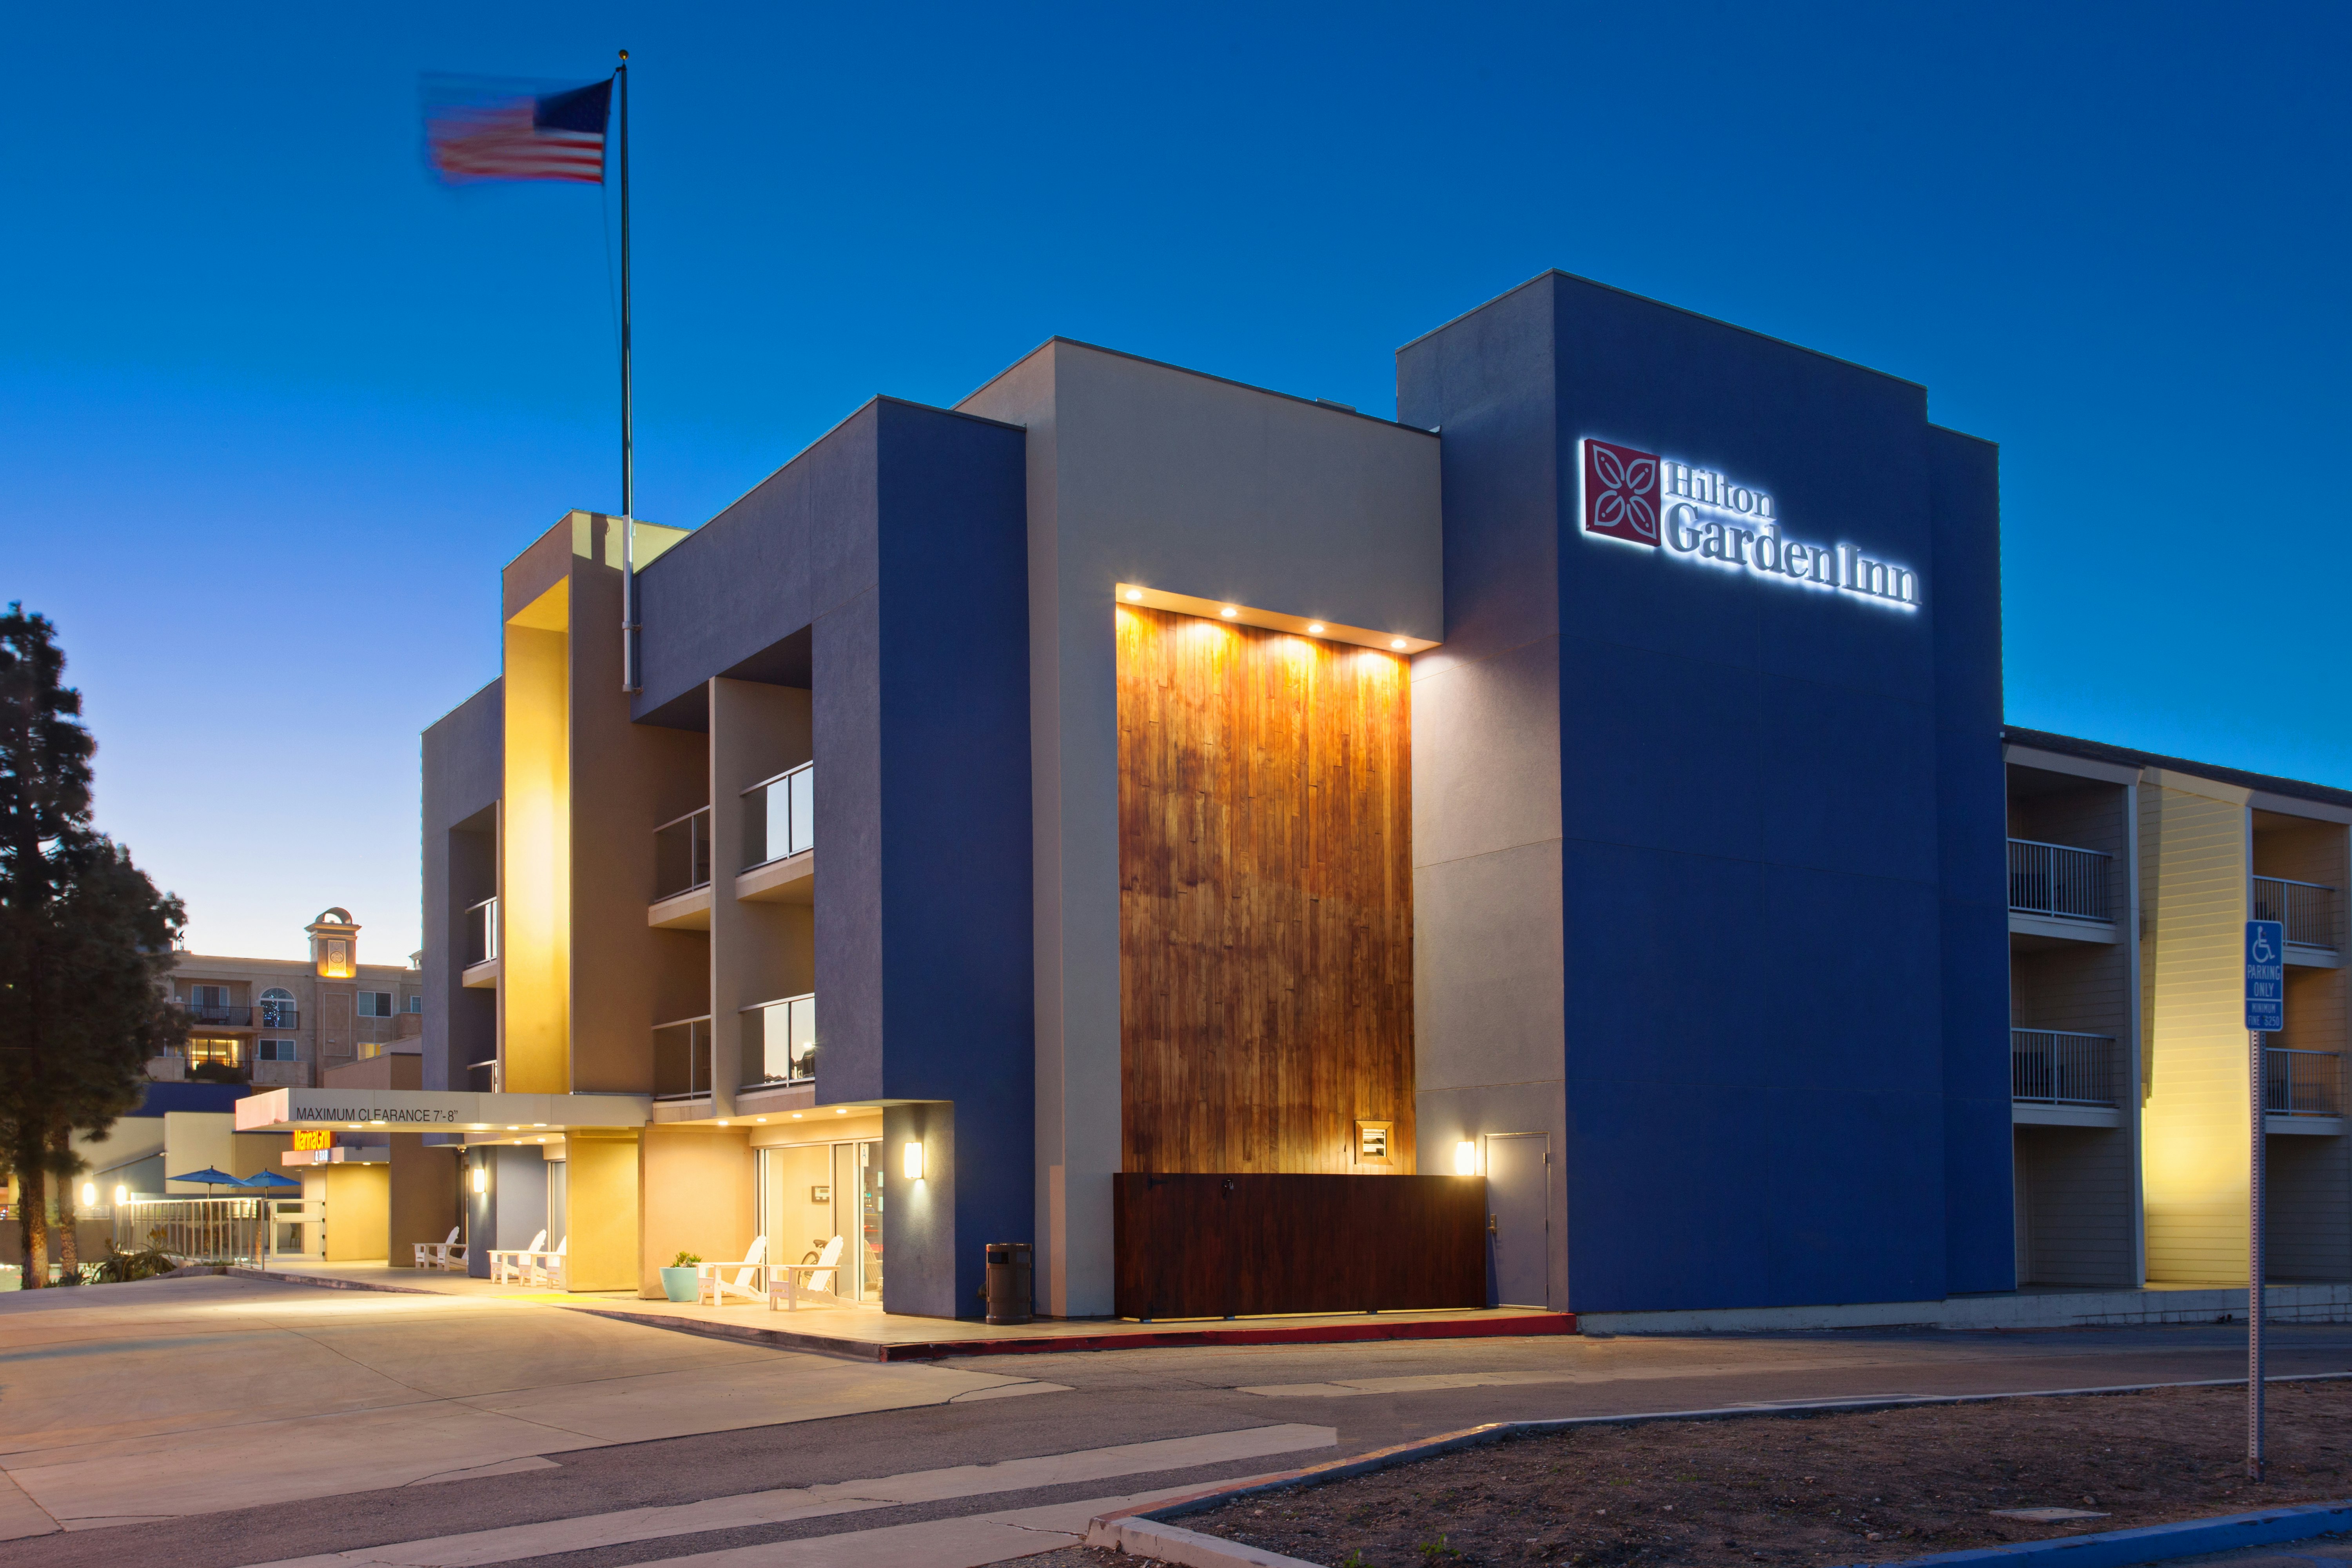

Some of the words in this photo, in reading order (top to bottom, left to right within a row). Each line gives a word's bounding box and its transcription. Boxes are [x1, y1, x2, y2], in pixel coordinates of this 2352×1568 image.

[1664, 461, 1777, 522] Hilton
[1665, 502, 1840, 588] Garden
[1838, 543, 1922, 605] Inn
[2247, 964, 2280, 980] PARKING
[2254, 982, 2274, 997] ONLY
[2251, 1003, 2276, 1013] MINIMUM
[2248, 1015, 2260, 1025] FINE
[2264, 1016, 2280, 1026] $250
[297, 1107, 355, 1121] MAXIMUM
[358, 1108, 430, 1122] CLEARANCE
[319, 1149, 328, 1161] BAR
[862, 1148, 866, 1159] A
